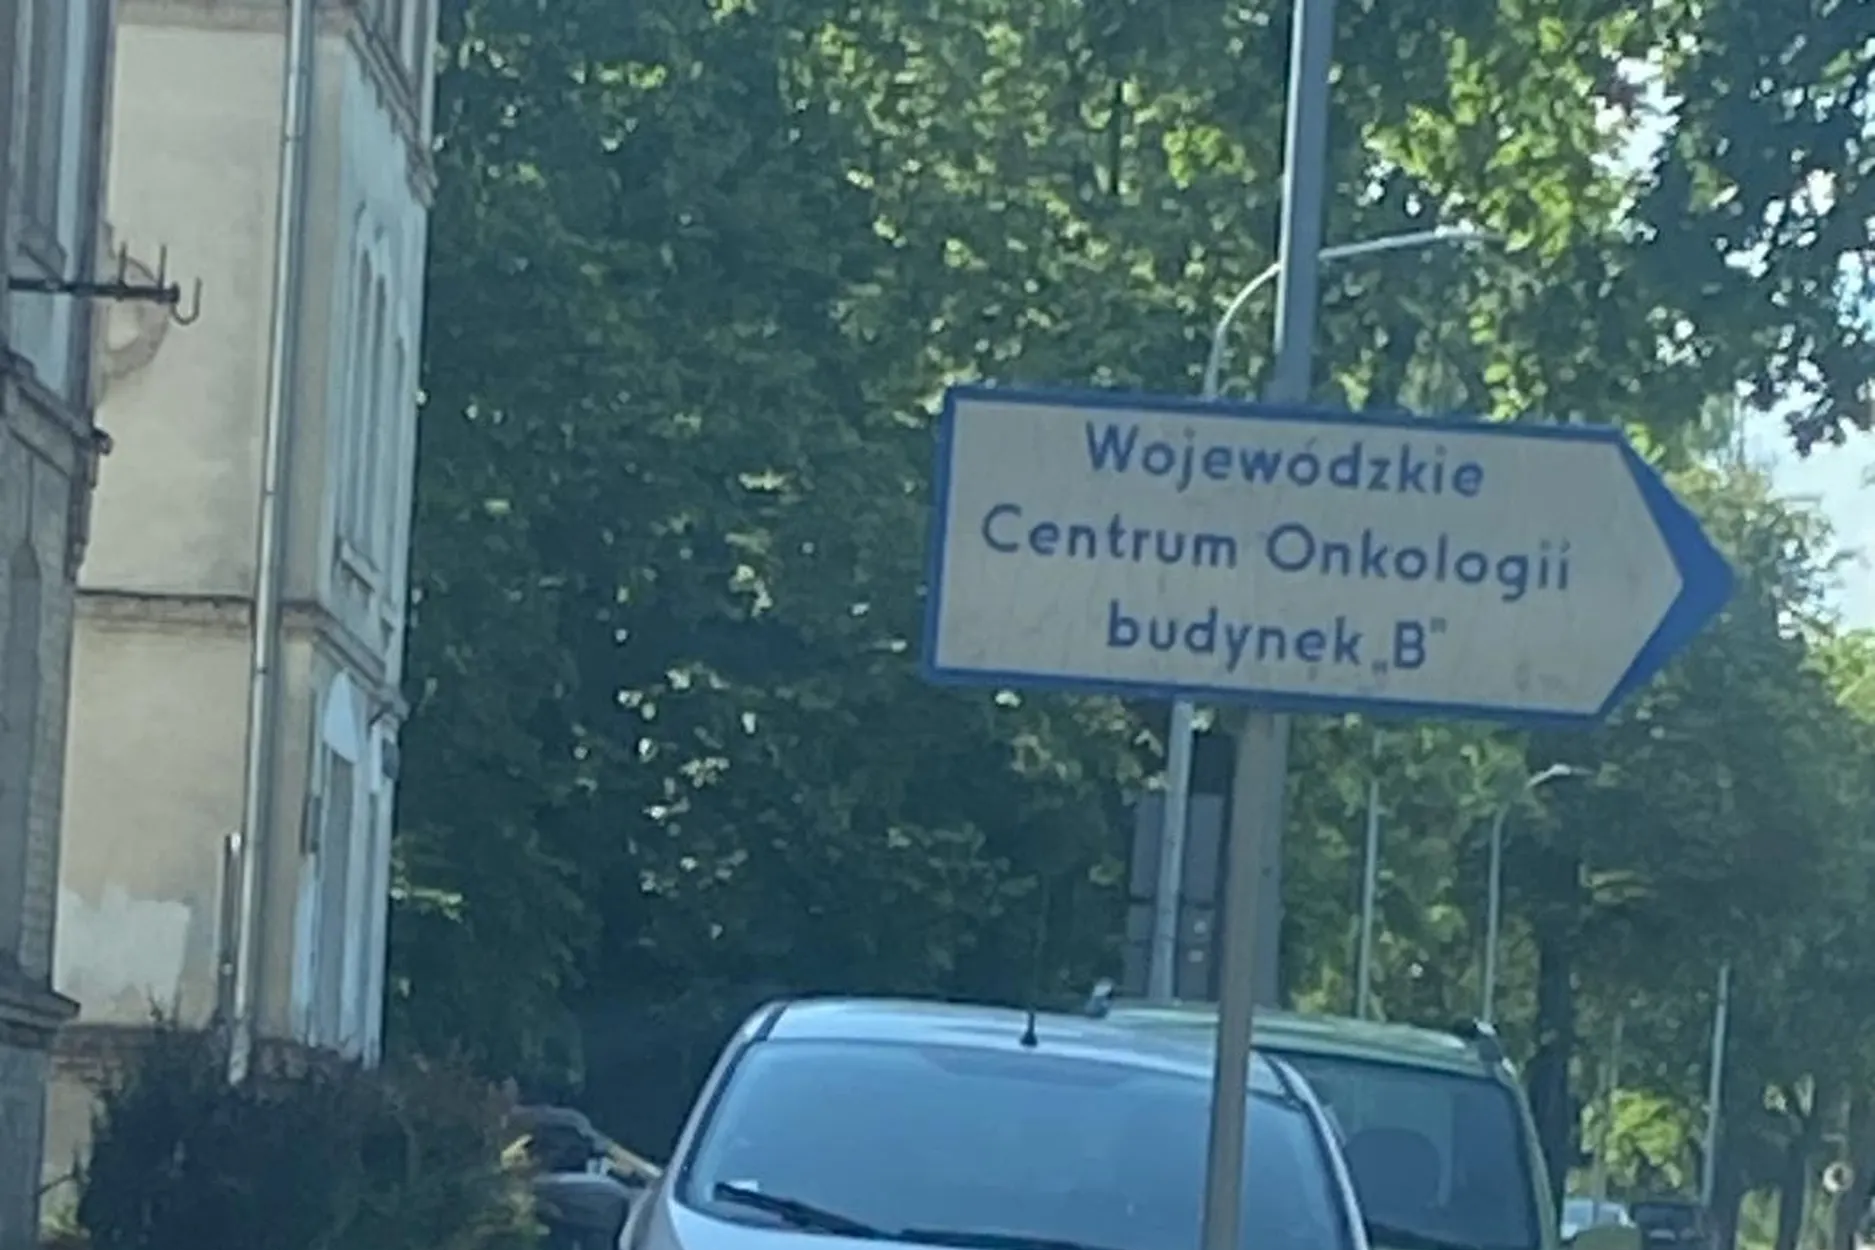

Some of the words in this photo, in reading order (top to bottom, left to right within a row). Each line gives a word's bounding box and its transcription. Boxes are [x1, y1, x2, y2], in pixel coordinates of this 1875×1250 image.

[1086, 422, 1484, 497] Wojewódzkie
[982, 504, 1238, 569] Centrum
[1266, 523, 1572, 601] Onkologii
[1107, 600, 1362, 671] budynek
